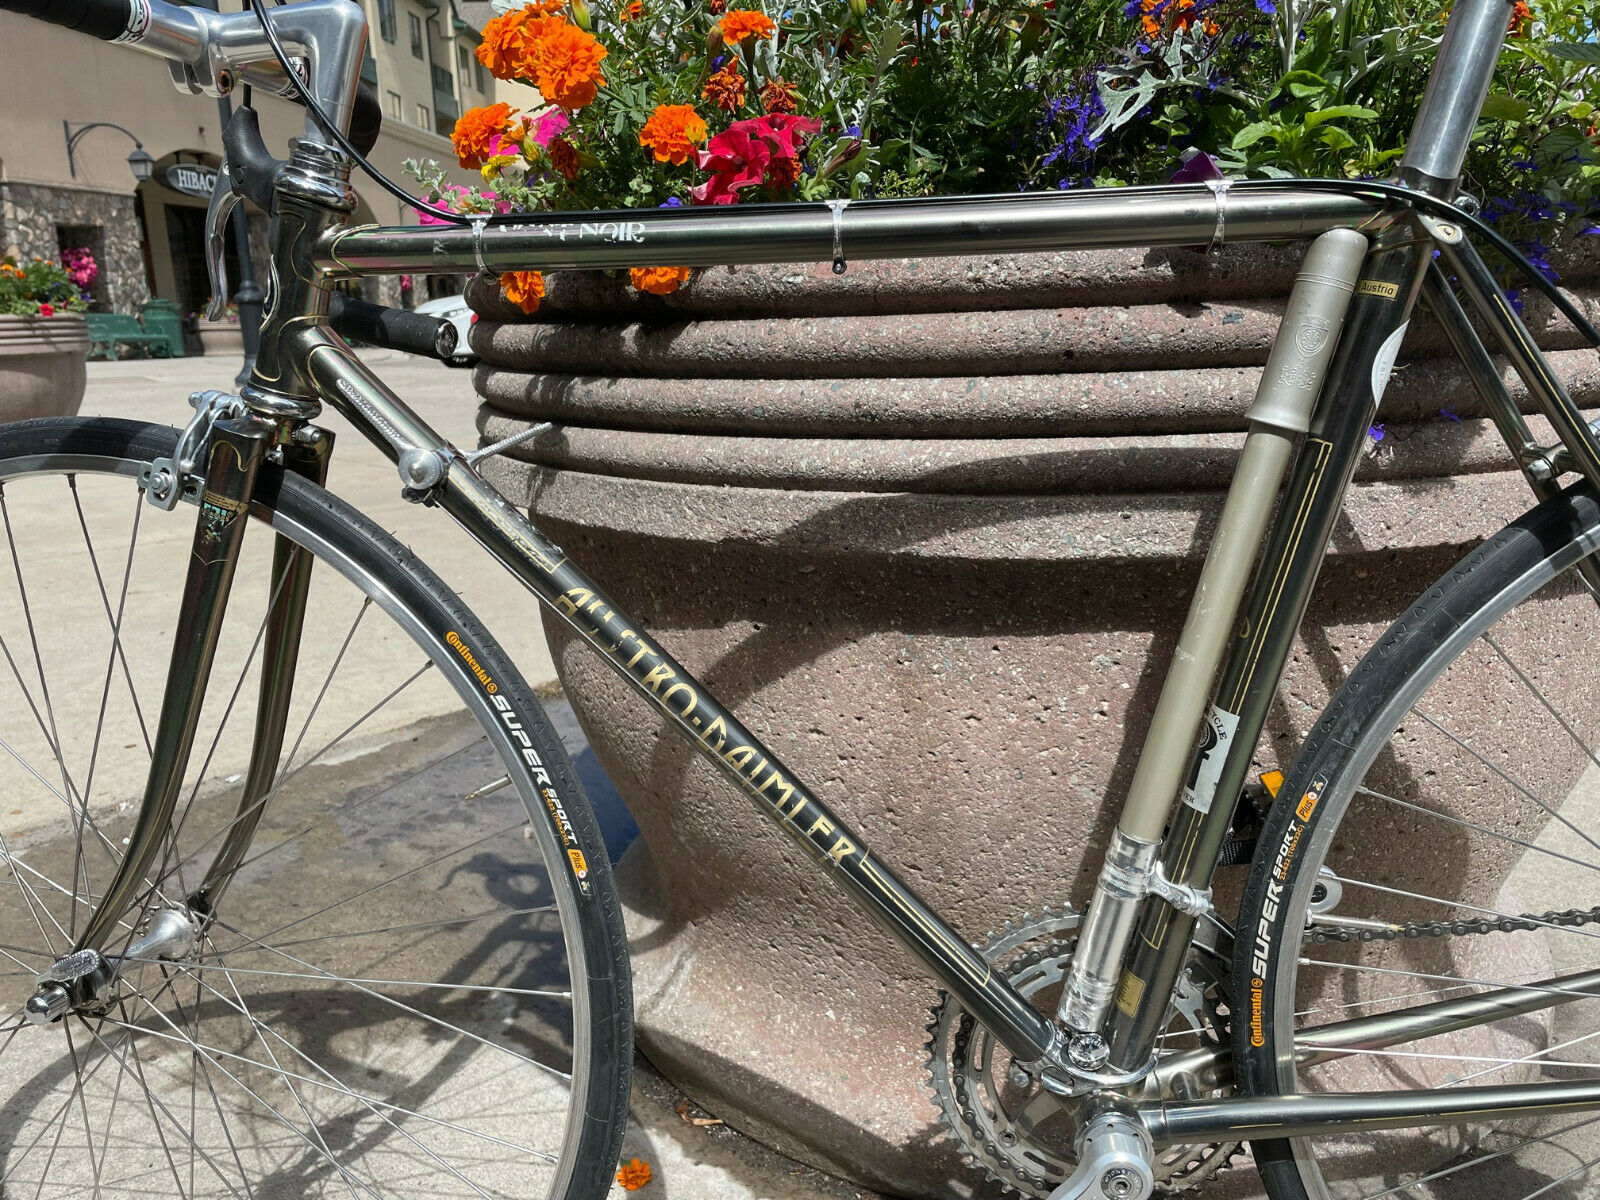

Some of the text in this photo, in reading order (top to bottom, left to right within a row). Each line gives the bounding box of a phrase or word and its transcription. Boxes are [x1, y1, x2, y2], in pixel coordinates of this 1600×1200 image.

[446, 631, 583, 870] Continental SUPER SPORT Plus
[1251, 799, 1313, 1047] Continental SUPER SPORT Plus
